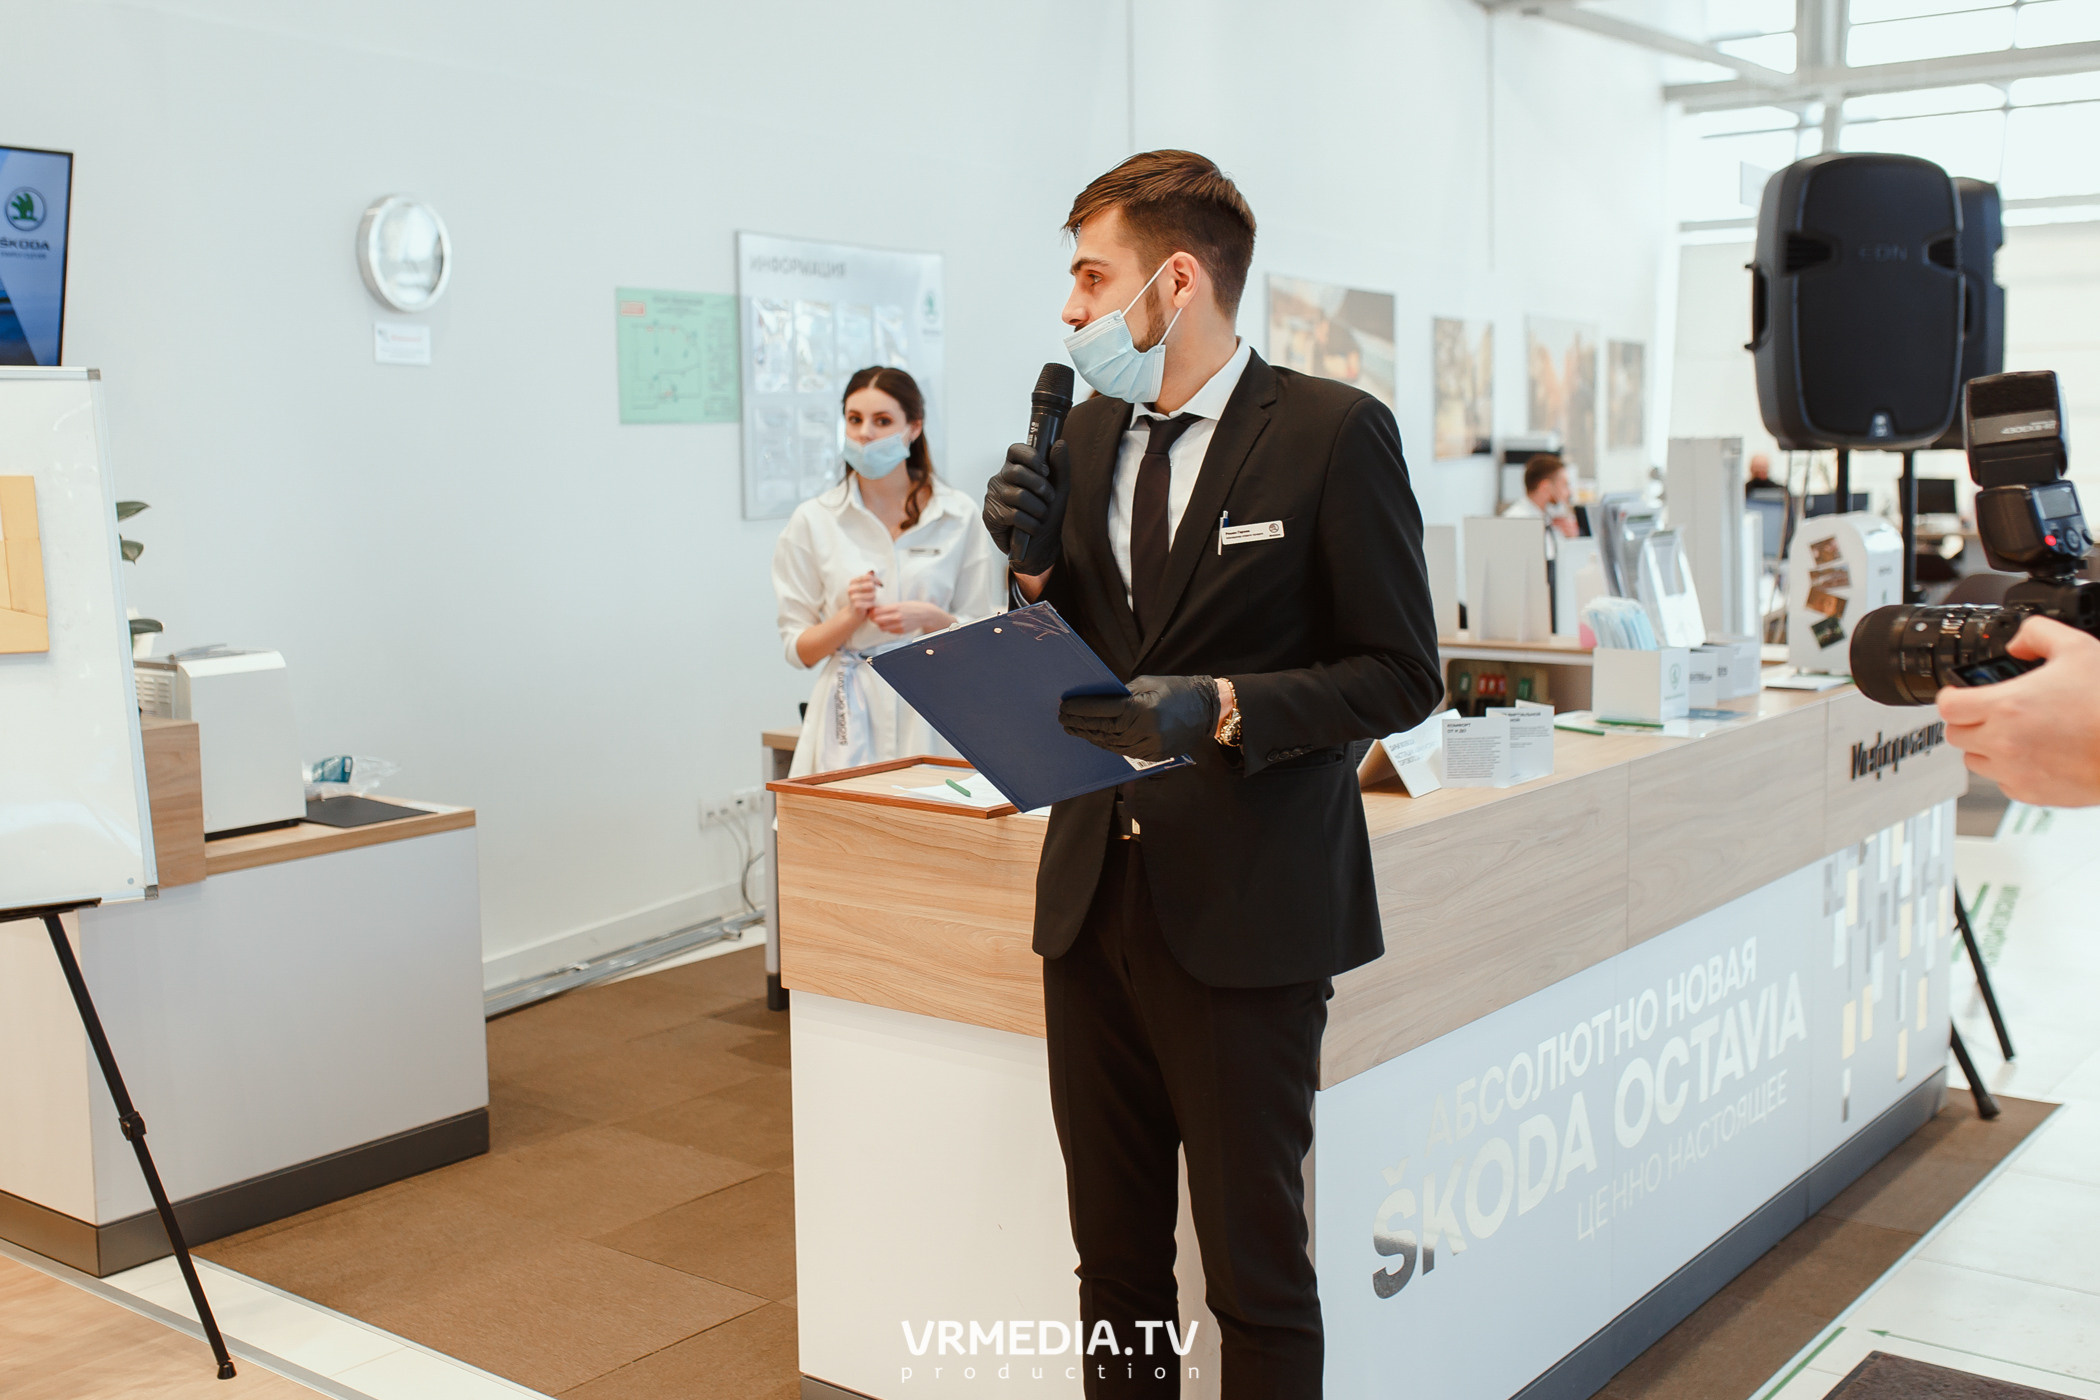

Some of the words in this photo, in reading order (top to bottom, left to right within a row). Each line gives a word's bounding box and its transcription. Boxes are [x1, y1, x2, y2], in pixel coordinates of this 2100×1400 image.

[1372, 1091, 1598, 1300] ŠKODA
[1614, 972, 1808, 1149] OCTAVIA
[1424, 988, 1659, 1159] АБСОЛЮТНО
[1667, 936, 1757, 1029] НОВАЯ
[1577, 1152, 1662, 1241] ЦЕННО
[1667, 1068, 1788, 1181] НАСТОЯЩЕЕ
